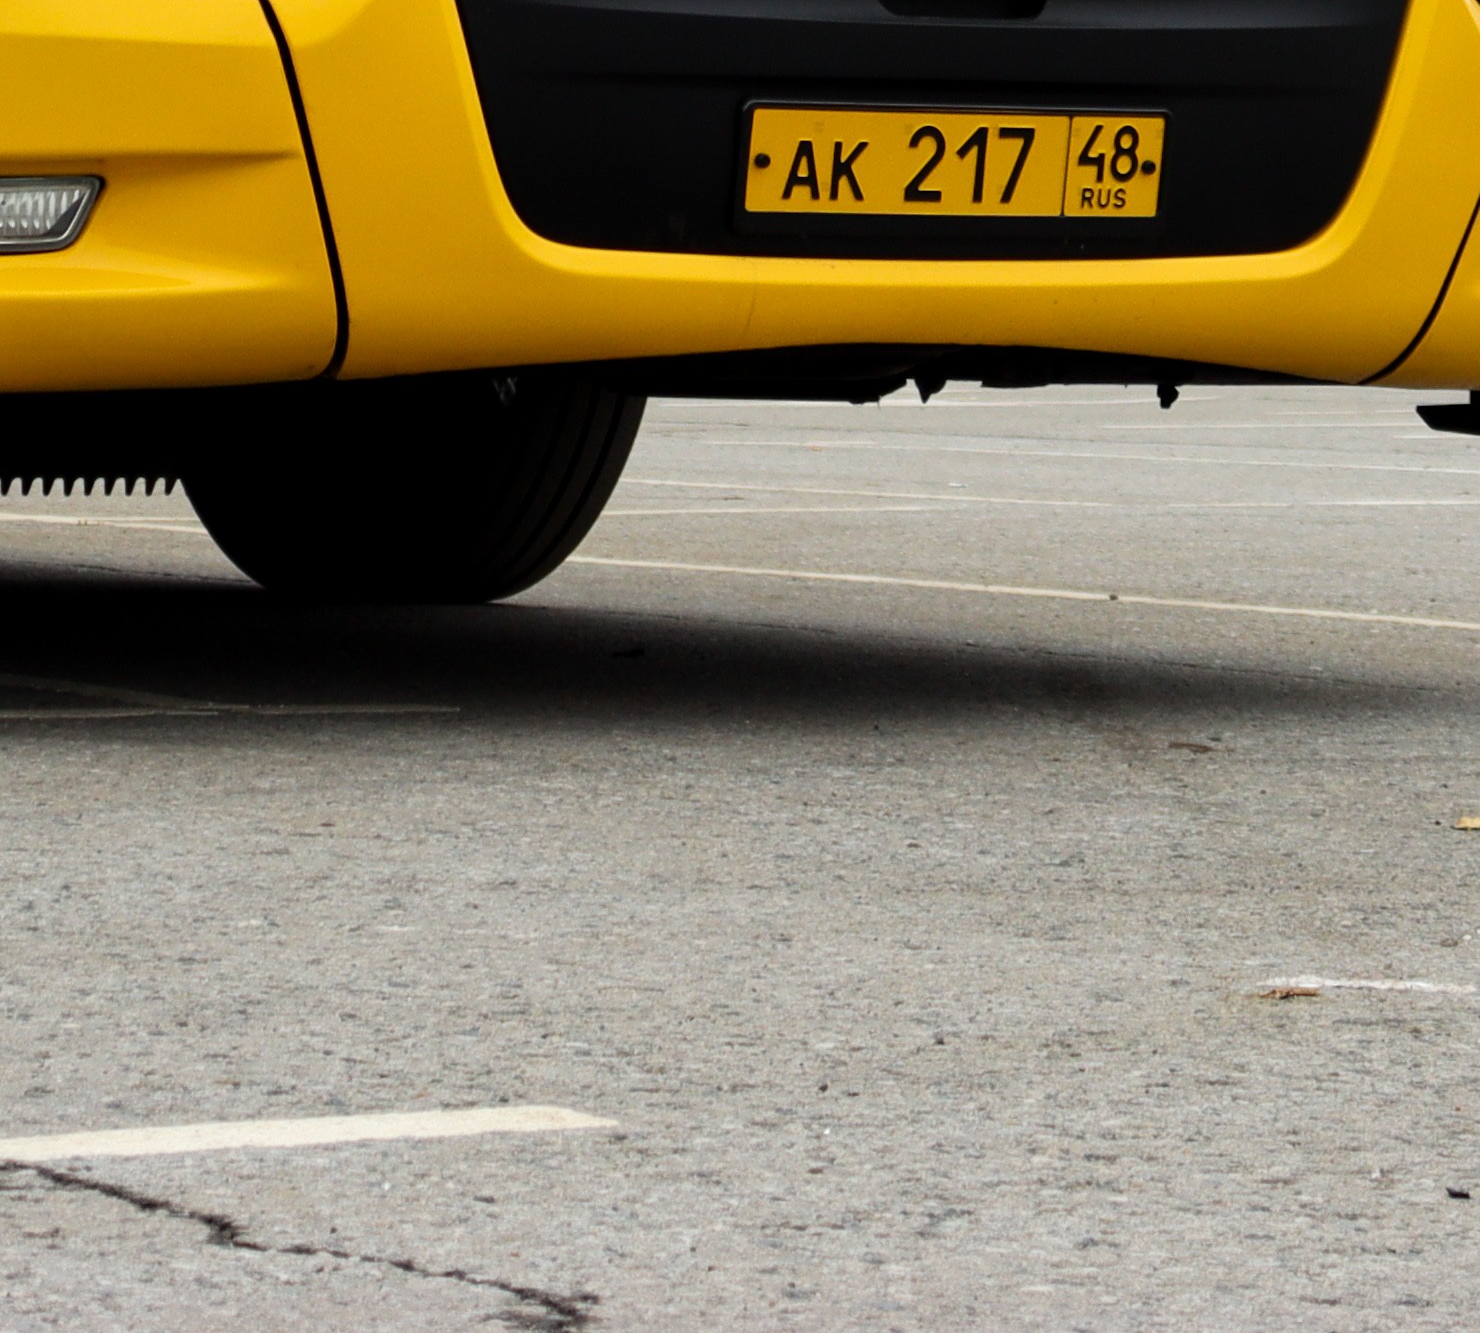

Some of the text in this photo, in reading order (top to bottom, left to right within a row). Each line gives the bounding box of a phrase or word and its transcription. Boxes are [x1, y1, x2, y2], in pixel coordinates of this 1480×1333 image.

[903, 125, 1036, 204] 217
[1076, 125, 1140, 183] 48
[1081, 188, 1127, 209] RUS
